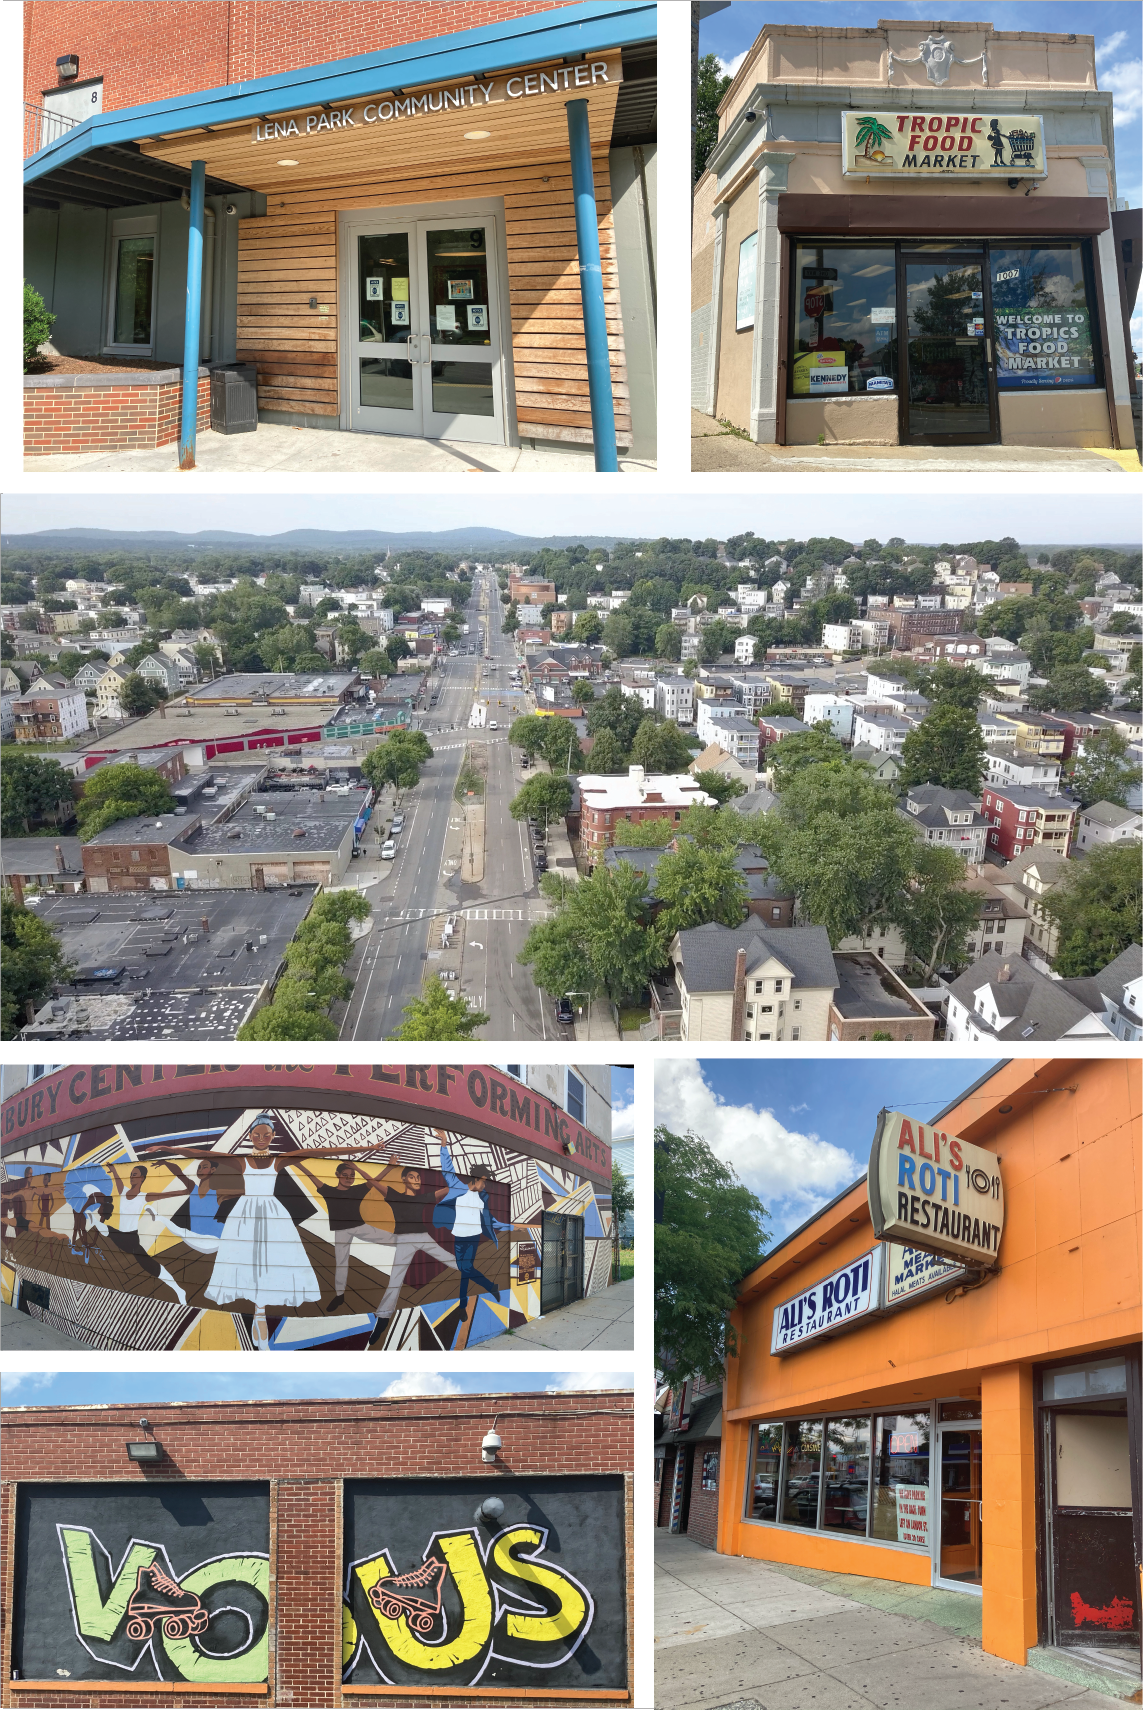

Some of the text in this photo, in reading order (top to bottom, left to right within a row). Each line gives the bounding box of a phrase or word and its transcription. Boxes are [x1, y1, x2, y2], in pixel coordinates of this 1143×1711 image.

[91, 91, 98, 104] 8
[256, 61, 609, 141] LENA PARK COMMUNITY CENTER
[896, 115, 983, 134] TROPIC
[908, 134, 974, 152] FOOD
[902, 154, 980, 168] MARKET
[470, 230, 483, 249] 9
[998, 269, 1019, 281] 1007
[996, 314, 1085, 324] WELCOME TO
[1004, 327, 1079, 340] TROPICS
[1018, 342, 1069, 354] FOOD
[1008, 356, 1081, 370] MARKET
[810, 374, 847, 383] KENNEDY
[68, 1064, 242, 1105] CEN
[575, 1130, 607, 1168] ARTS
[897, 1118, 964, 1171] ALI'S
[897, 1152, 960, 1206] ROTI
[897, 1191, 1001, 1252] RESTAURANT
[894, 1255, 945, 1286] MARK
[903, 1251, 935, 1271] MEA
[779, 1259, 870, 1334] ALI'S ROTI
[891, 1286, 906, 1298] HALAL
[908, 1276, 926, 1290] MEATS
[782, 1297, 861, 1344] RESTAURANT
[801, 1444, 821, 1452] CUISINE
[890, 1434, 918, 1454] OPEN
